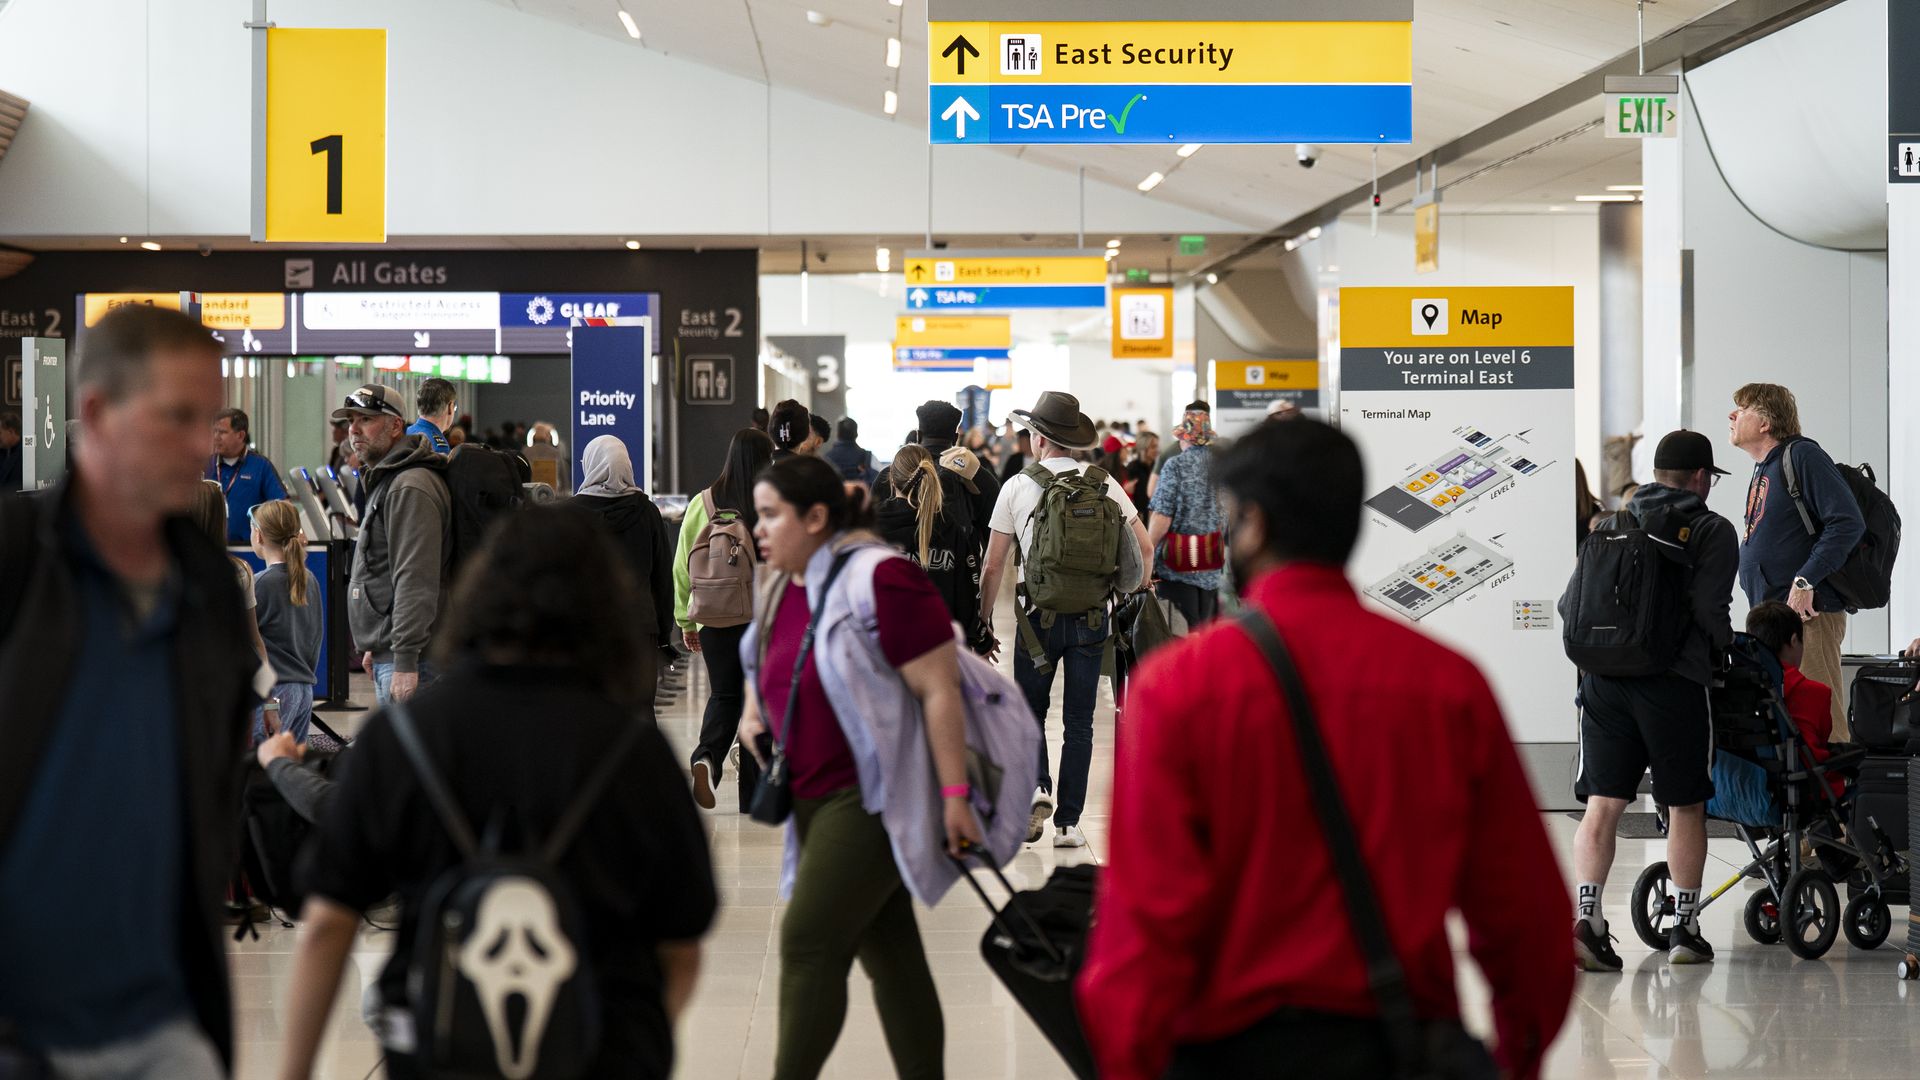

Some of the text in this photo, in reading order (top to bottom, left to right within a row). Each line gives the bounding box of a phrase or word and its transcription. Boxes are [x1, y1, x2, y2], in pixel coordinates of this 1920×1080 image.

[1056, 42, 1234, 71] East Security
[1001, 104, 1053, 129] TSA
[1619, 98, 1666, 133] EXIT
[310, 135, 342, 214] 1
[332, 262, 447, 284] All Gates
[959, 267, 982, 277] East
[986, 267, 1031, 278] Security
[560, 303, 617, 318] CLEAR
[1461, 309, 1502, 329] Map
[1, 308, 62, 337] East 2
[681, 308, 743, 337] East 2
[678, 326, 719, 340] Security
[1384, 350, 1531, 364] You are on Level 6
[816, 355, 839, 393] 3
[1401, 370, 1514, 384] Terminal East
[580, 390, 636, 410] Priority
[581, 410, 616, 426] Lane
[1361, 409, 1431, 421] Terminal Map
[1490, 485, 1510, 500] LEVEL
[1491, 574, 1511, 589] LEVEL
